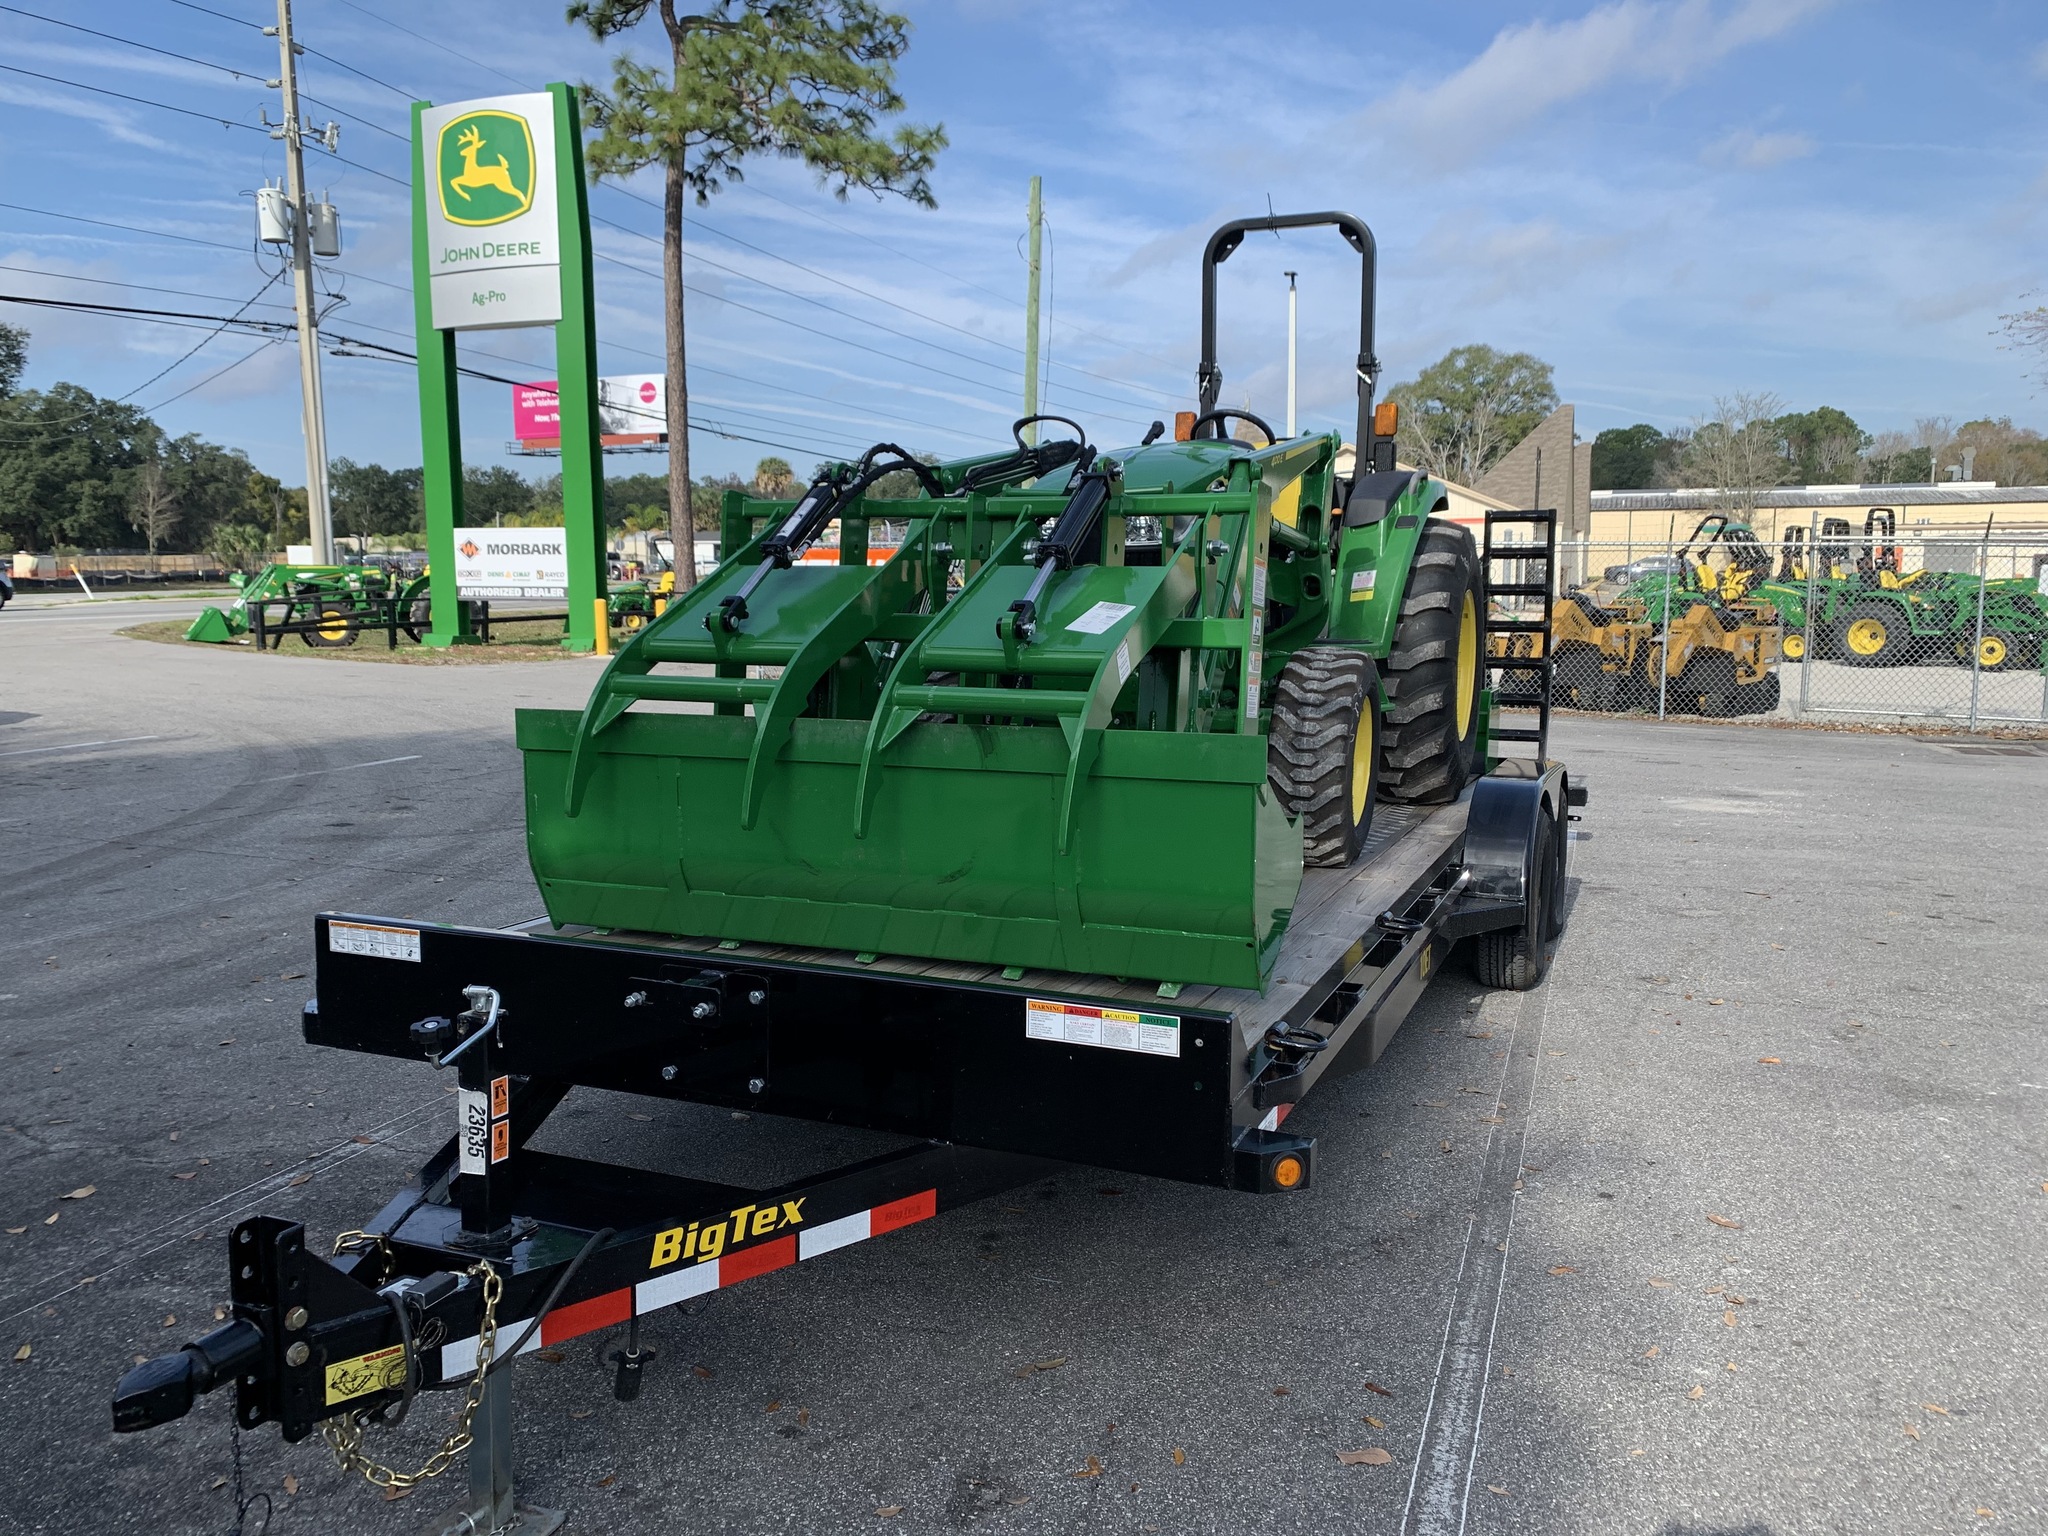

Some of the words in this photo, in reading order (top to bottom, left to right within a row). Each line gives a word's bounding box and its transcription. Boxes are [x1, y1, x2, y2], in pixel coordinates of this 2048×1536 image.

[441, 246, 480, 264] JOHN
[482, 241, 541, 258] DEERE
[472, 291, 506, 306] Ag-Pro
[521, 399, 536, 408] with
[487, 543, 562, 555] MORBARK
[460, 587, 522, 597] AUTHORIZED
[524, 588, 565, 597] DEALER
[1031, 1002, 1062, 1012] WARNING
[1074, 1008, 1099, 1016] DANGER
[1110, 1012, 1136, 1021] CAUTION
[1146, 1016, 1171, 1025] NOTICE
[467, 1104, 487, 1158] 23635
[649, 1196, 807, 1269] BigTex
